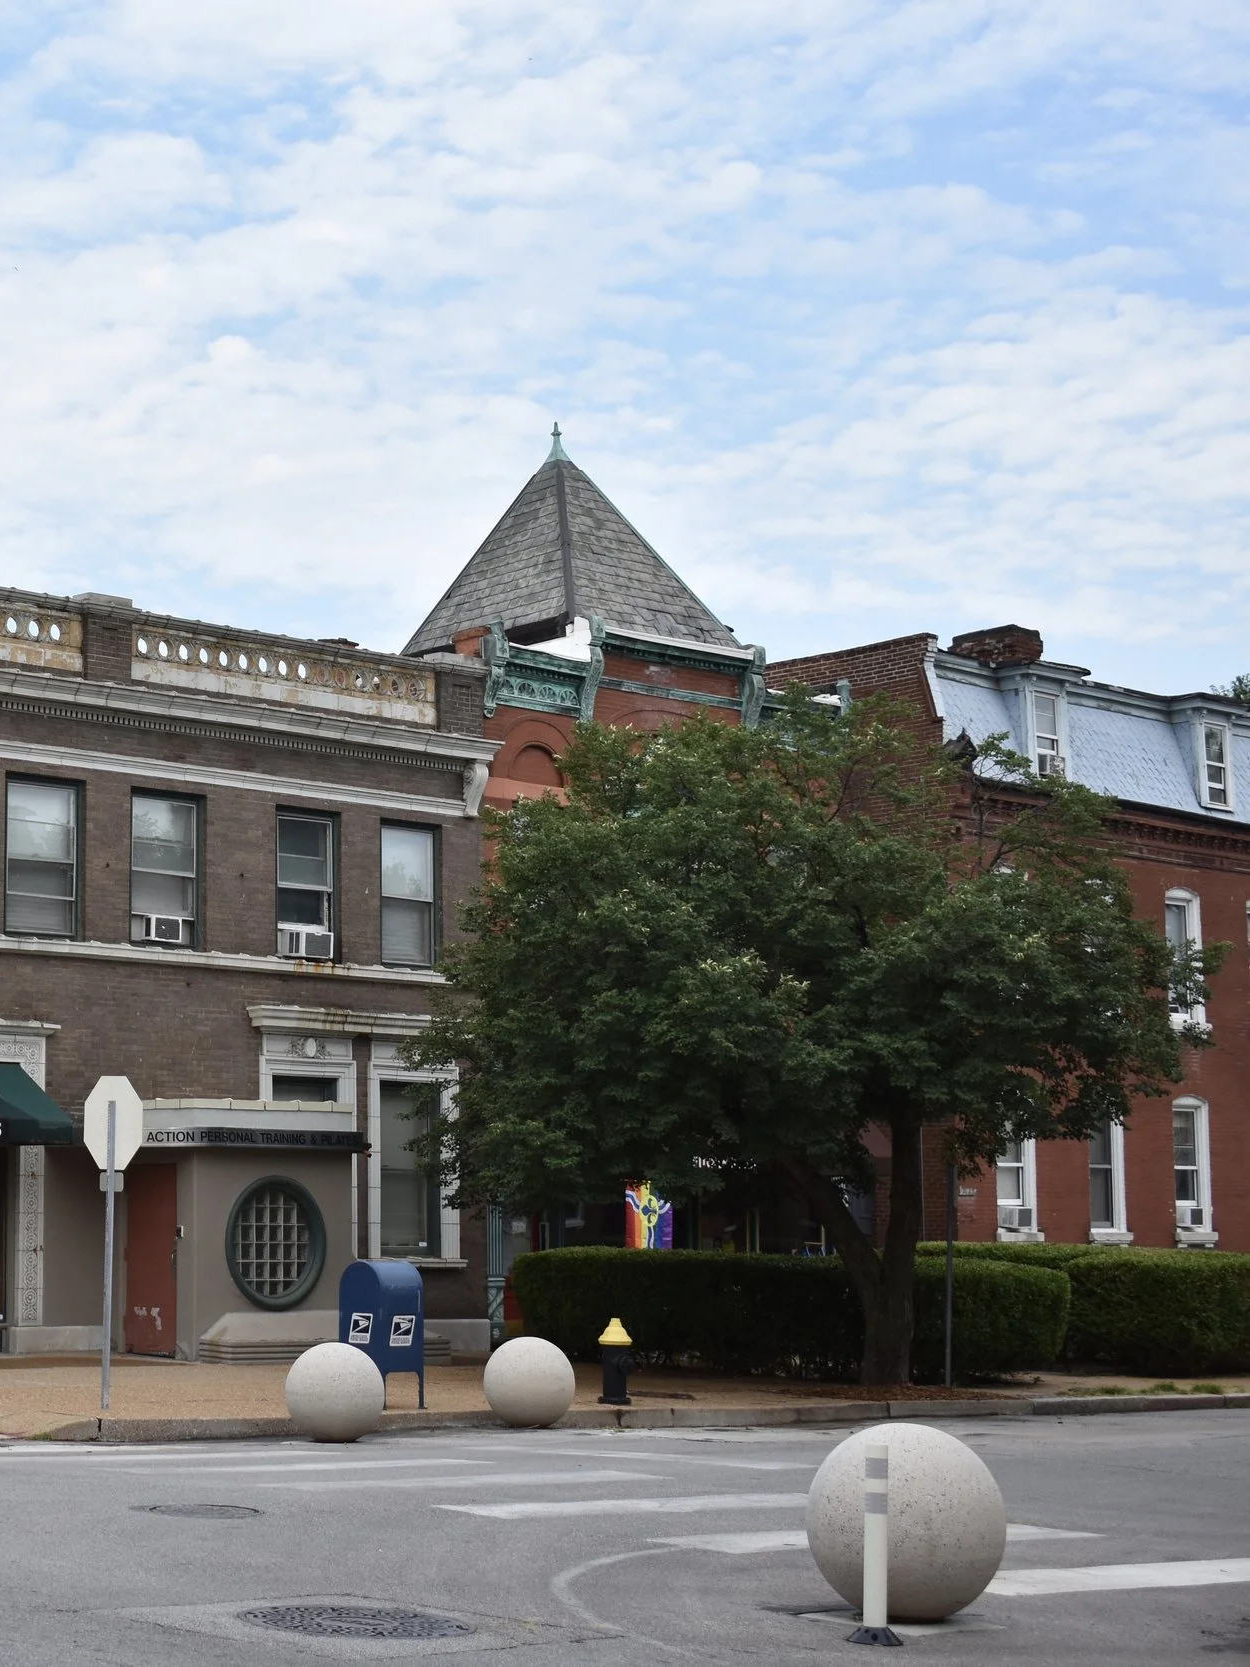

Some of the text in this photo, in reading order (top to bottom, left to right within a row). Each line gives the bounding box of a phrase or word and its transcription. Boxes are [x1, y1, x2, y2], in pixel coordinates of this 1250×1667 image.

[146, 1131, 359, 1146] ACTION PERSONAL TRAINING & PILATES
